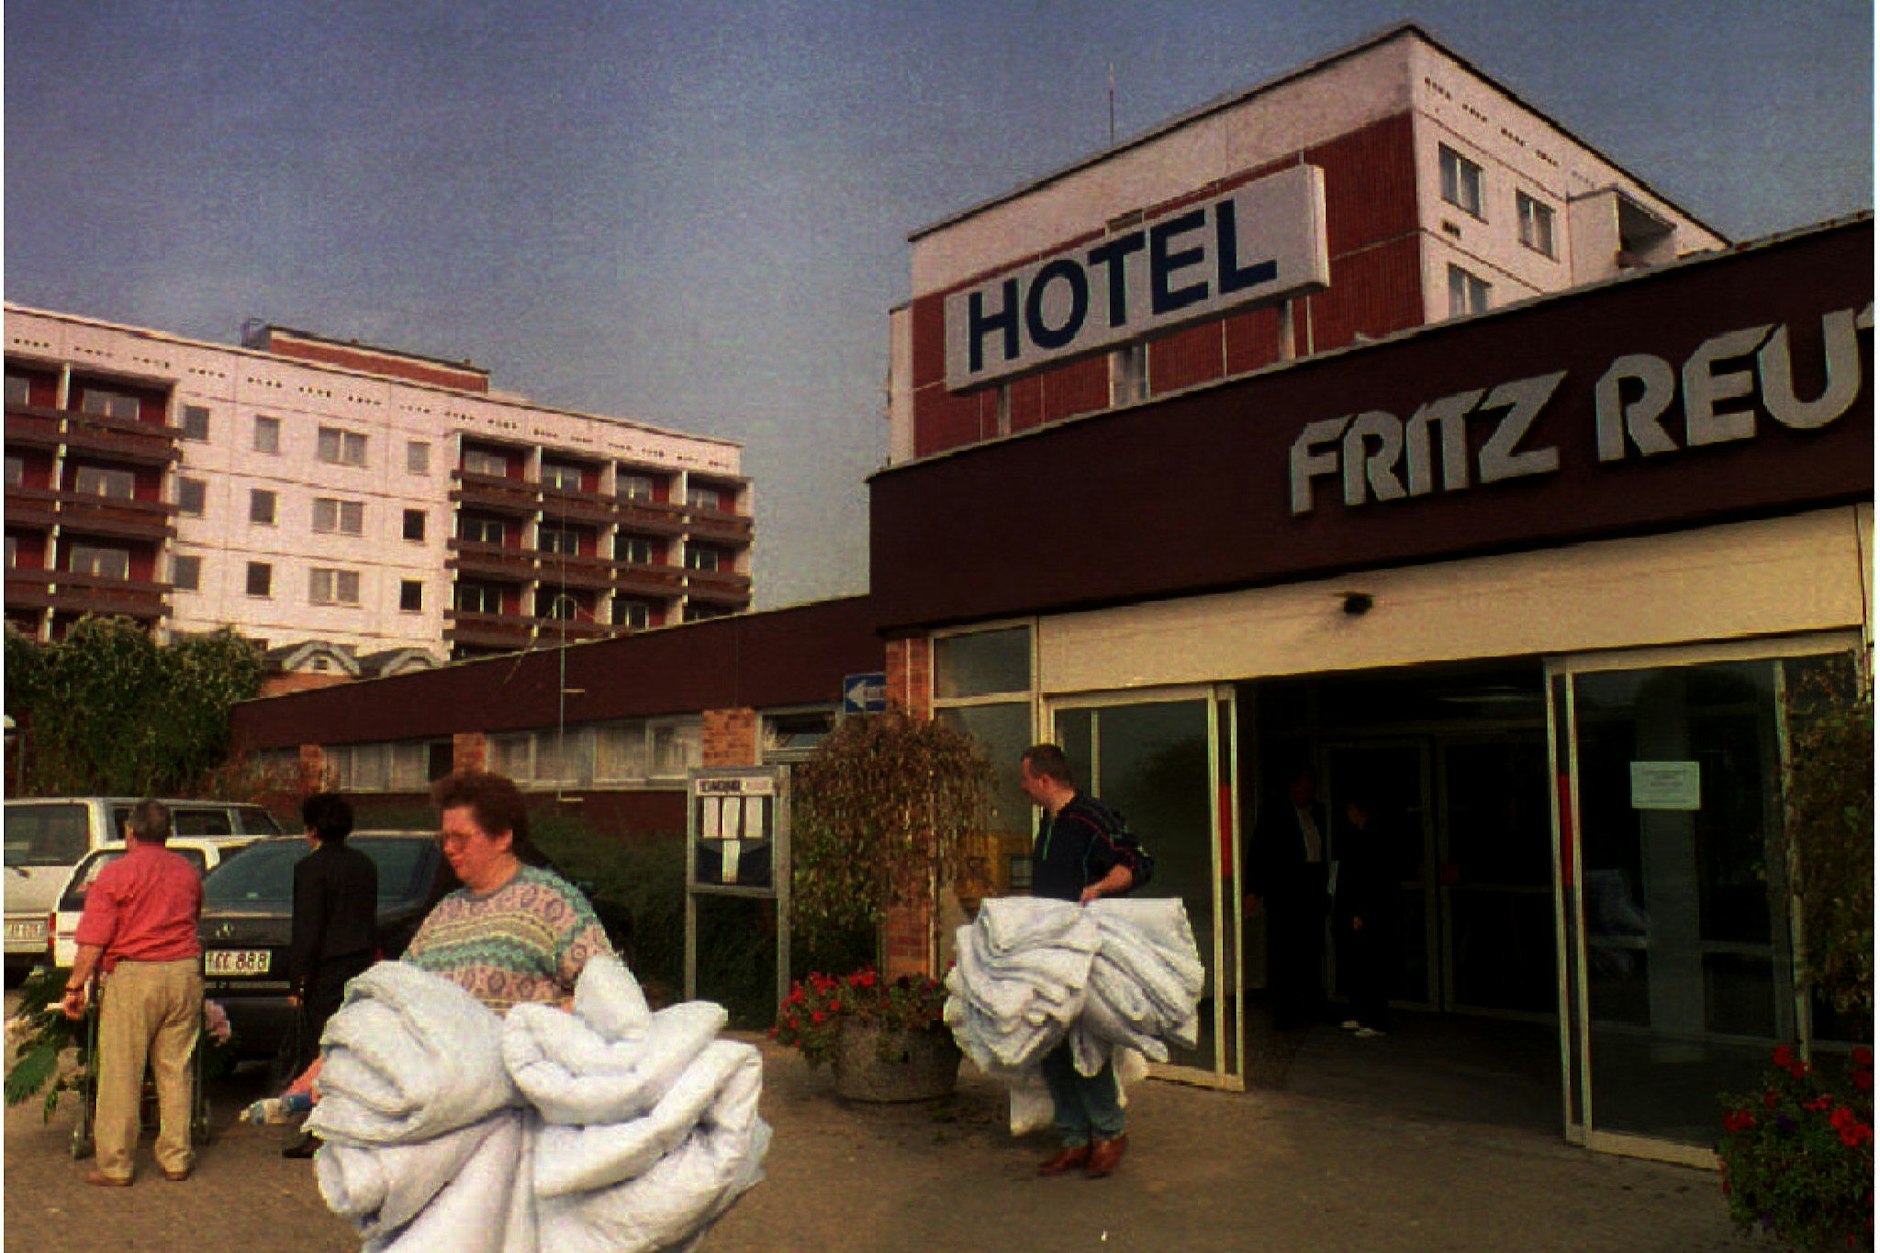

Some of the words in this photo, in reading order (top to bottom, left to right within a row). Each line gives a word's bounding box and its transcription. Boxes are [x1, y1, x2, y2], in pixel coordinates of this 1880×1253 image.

[968, 198, 1277, 374] HOTEL
[1290, 369, 1568, 516] FRITZ
[1595, 301, 1874, 462] REU
